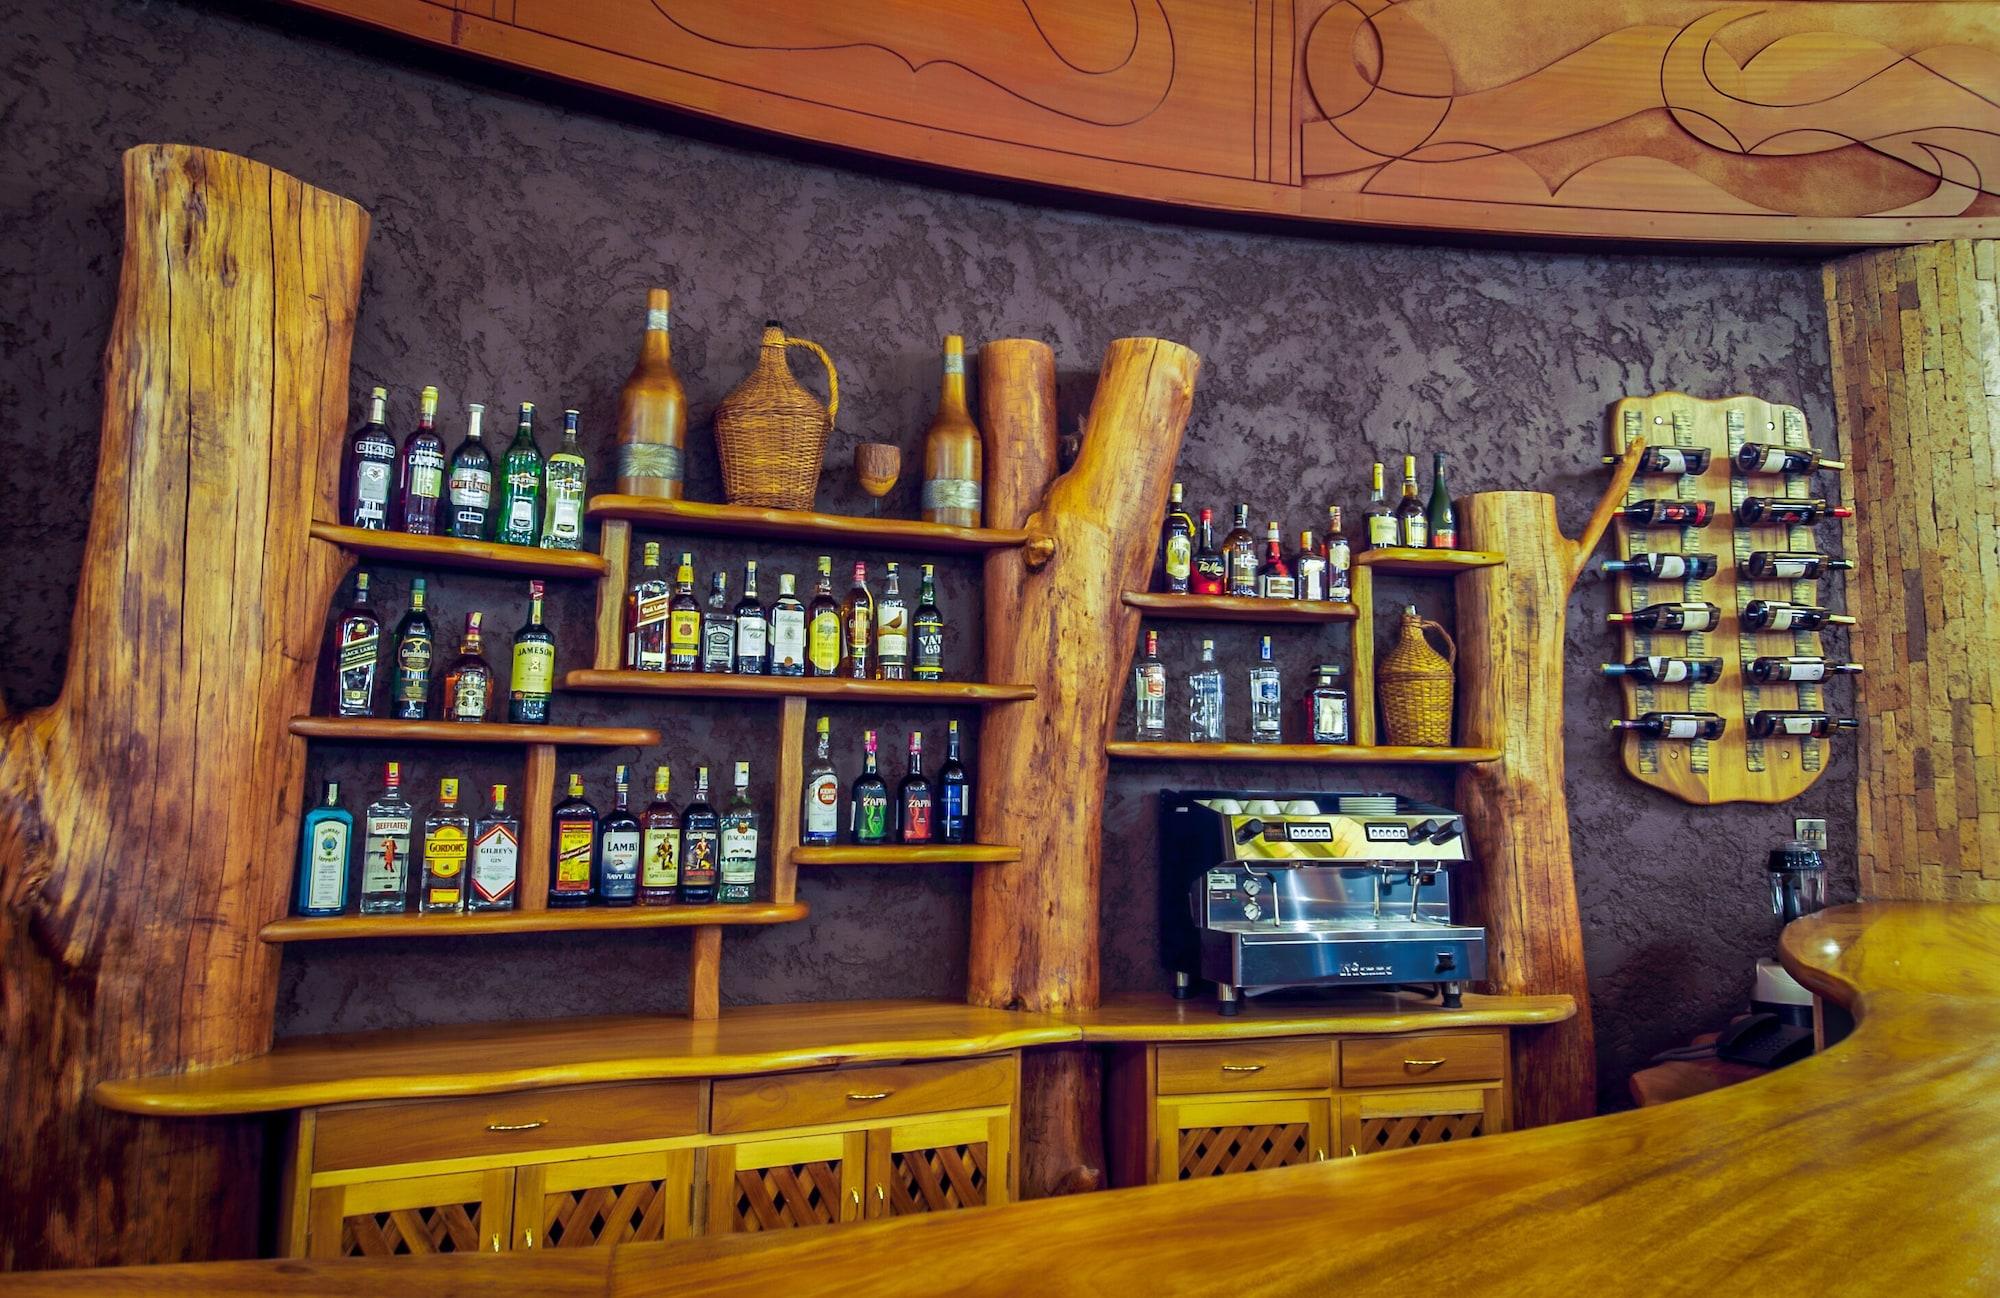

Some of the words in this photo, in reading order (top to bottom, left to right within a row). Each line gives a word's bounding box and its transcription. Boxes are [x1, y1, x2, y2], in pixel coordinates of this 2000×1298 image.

[358, 442, 393, 456] RICARD
[642, 607, 653, 616] Red
[919, 635, 942, 646] VAT
[517, 647, 553, 657] JAMESON
[925, 645, 940, 654] 69
[375, 821, 409, 831] BEEFEATER
[480, 847, 514, 855] GILBEY'S
